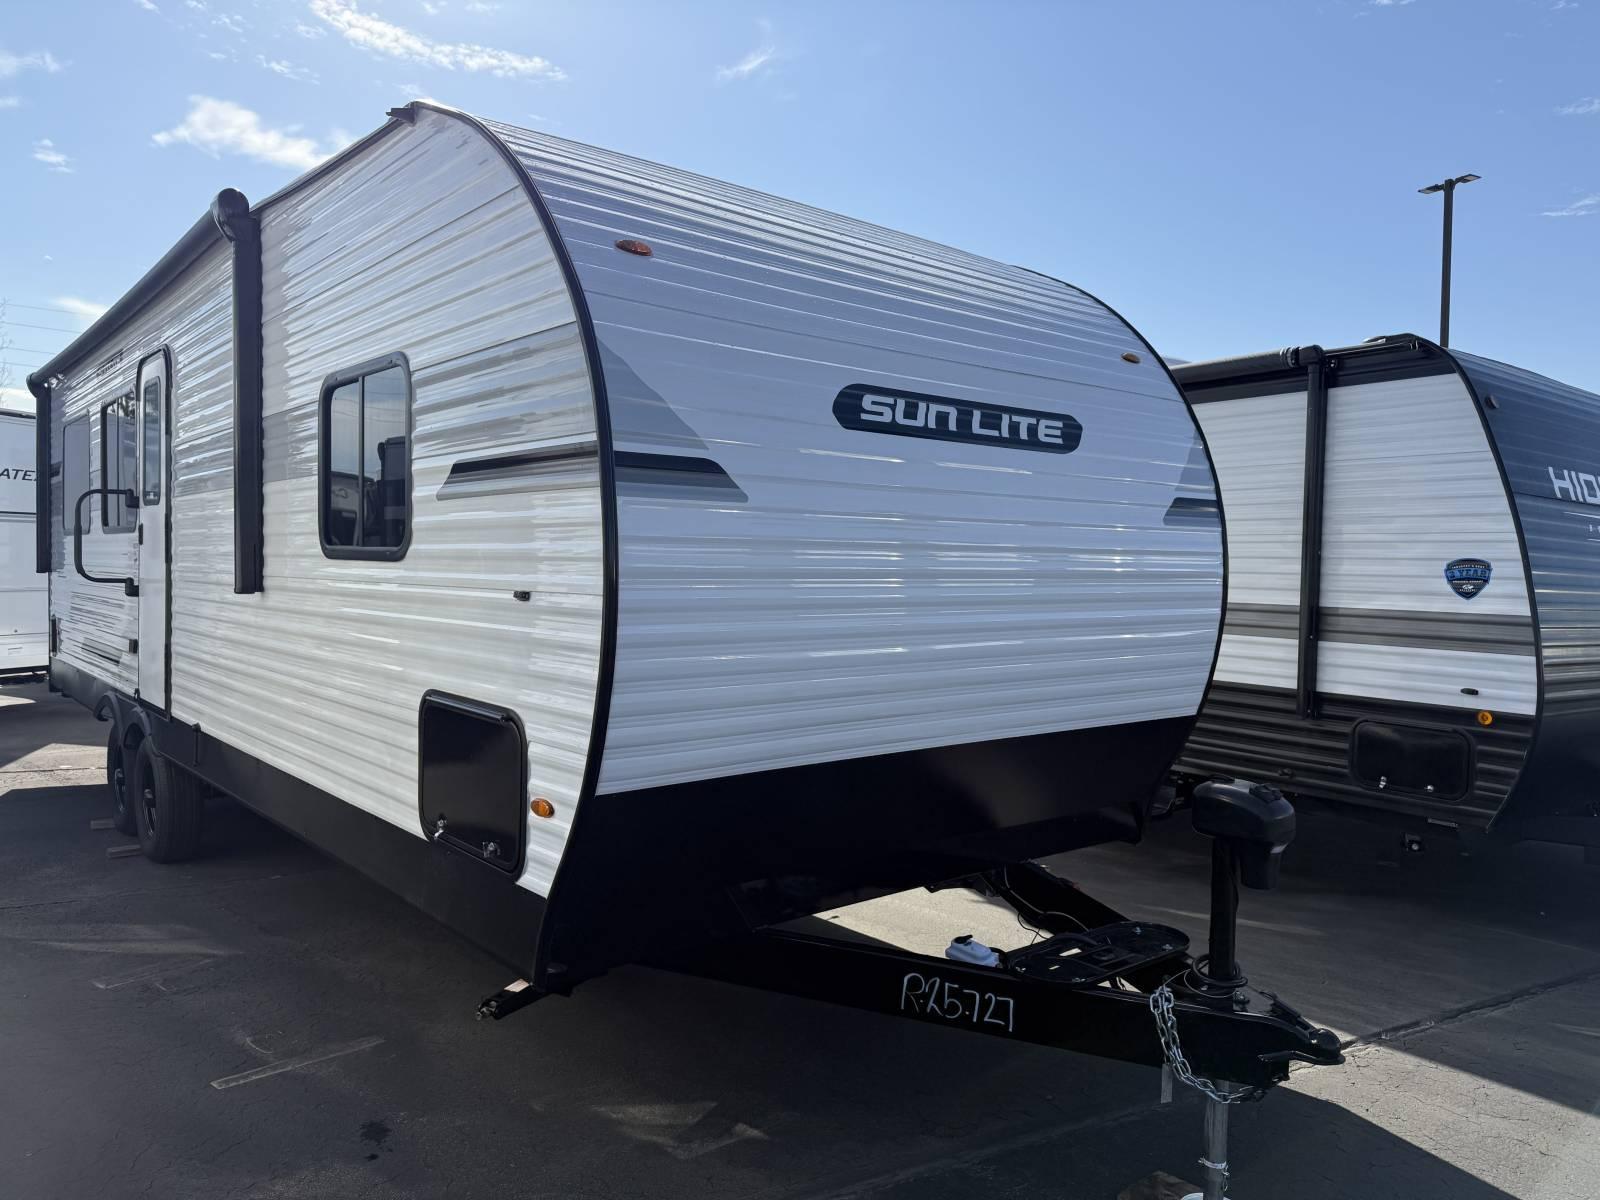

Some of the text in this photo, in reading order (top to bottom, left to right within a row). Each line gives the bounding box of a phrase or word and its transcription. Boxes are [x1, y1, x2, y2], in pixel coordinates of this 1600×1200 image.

[860, 394, 1064, 444] SUN LITE
[0, 468, 37, 481] ATE
[1548, 466, 1600, 505] HID
[1457, 568, 1487, 578] YEAR
